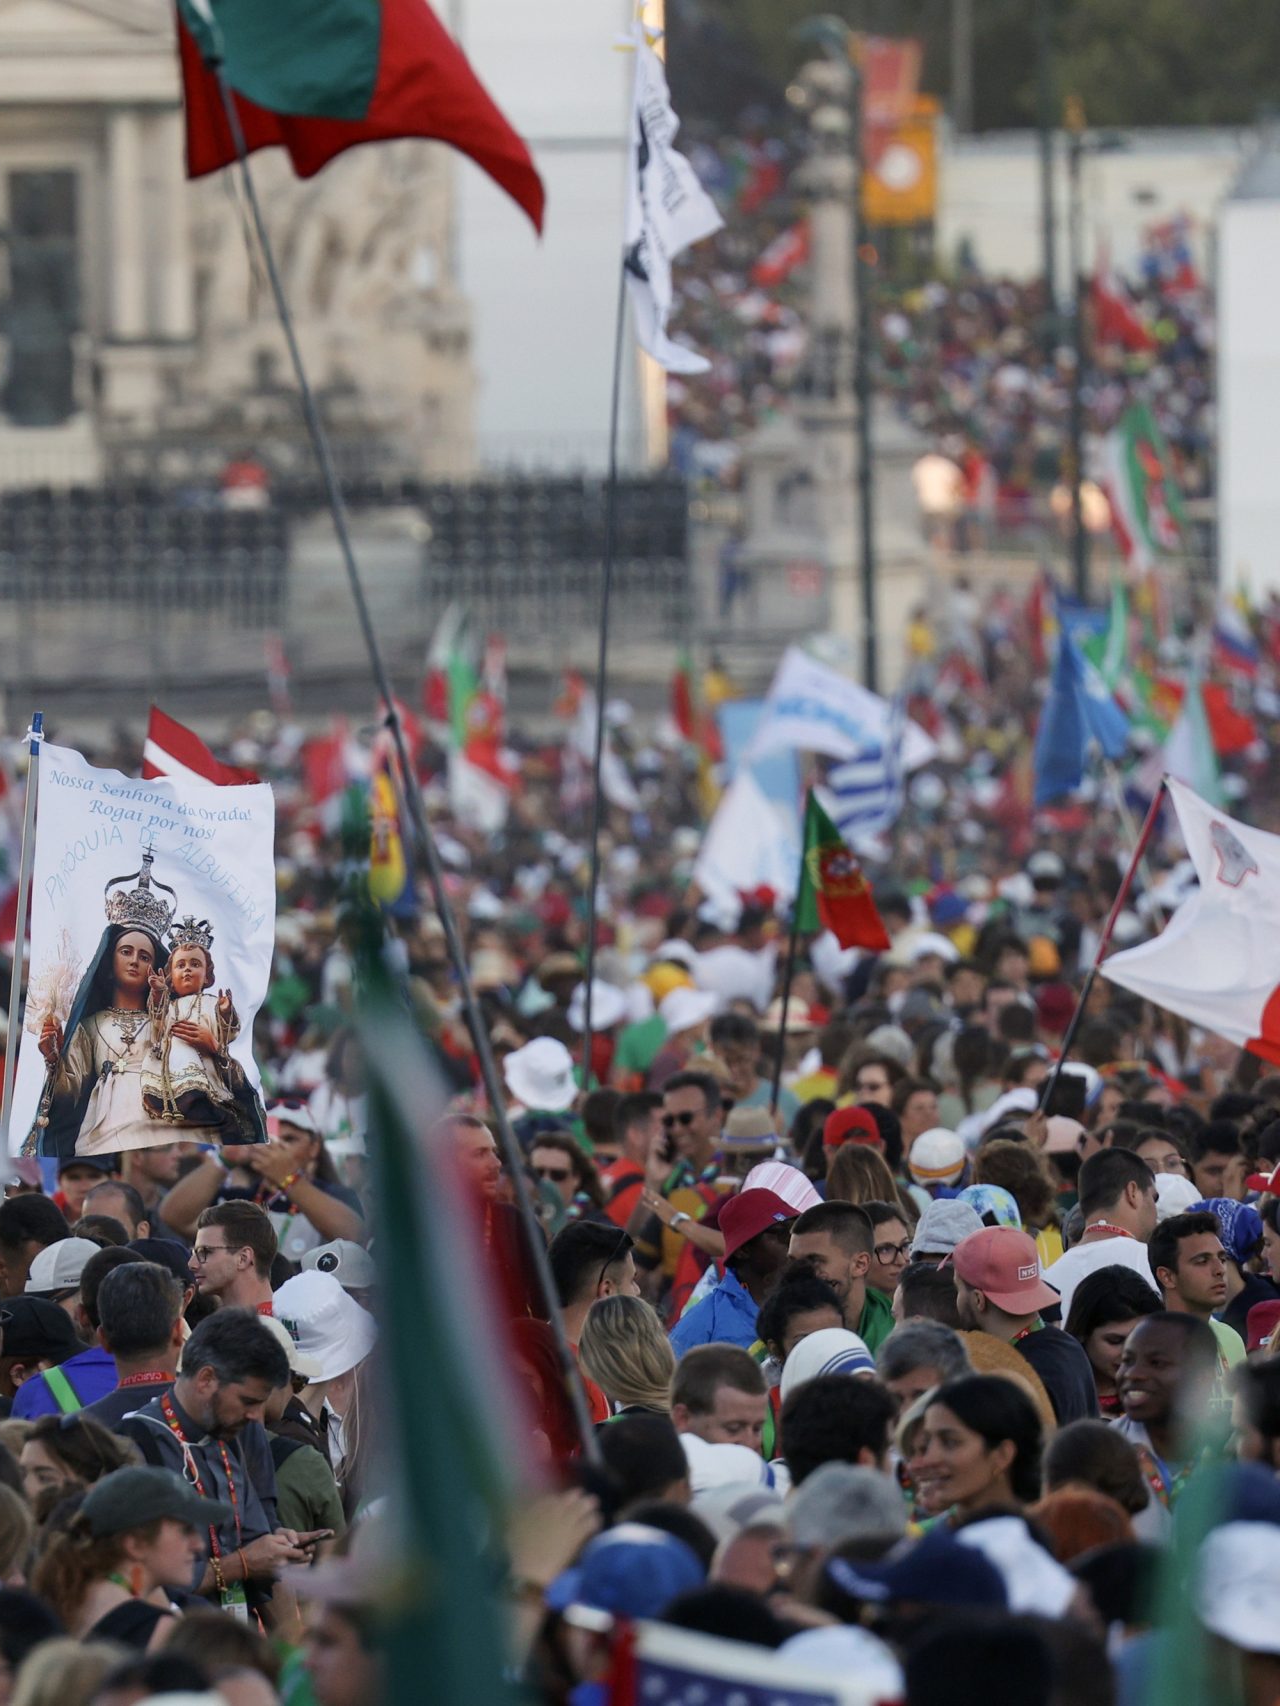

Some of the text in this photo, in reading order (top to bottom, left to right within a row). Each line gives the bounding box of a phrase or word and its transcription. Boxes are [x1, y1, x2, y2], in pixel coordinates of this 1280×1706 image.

[49, 770, 95, 792] Nossa
[99, 782, 173, 811] Senhora
[89, 799, 144, 824] Rogai
[149, 814, 181, 836] por
[139, 826, 161, 848] DE
